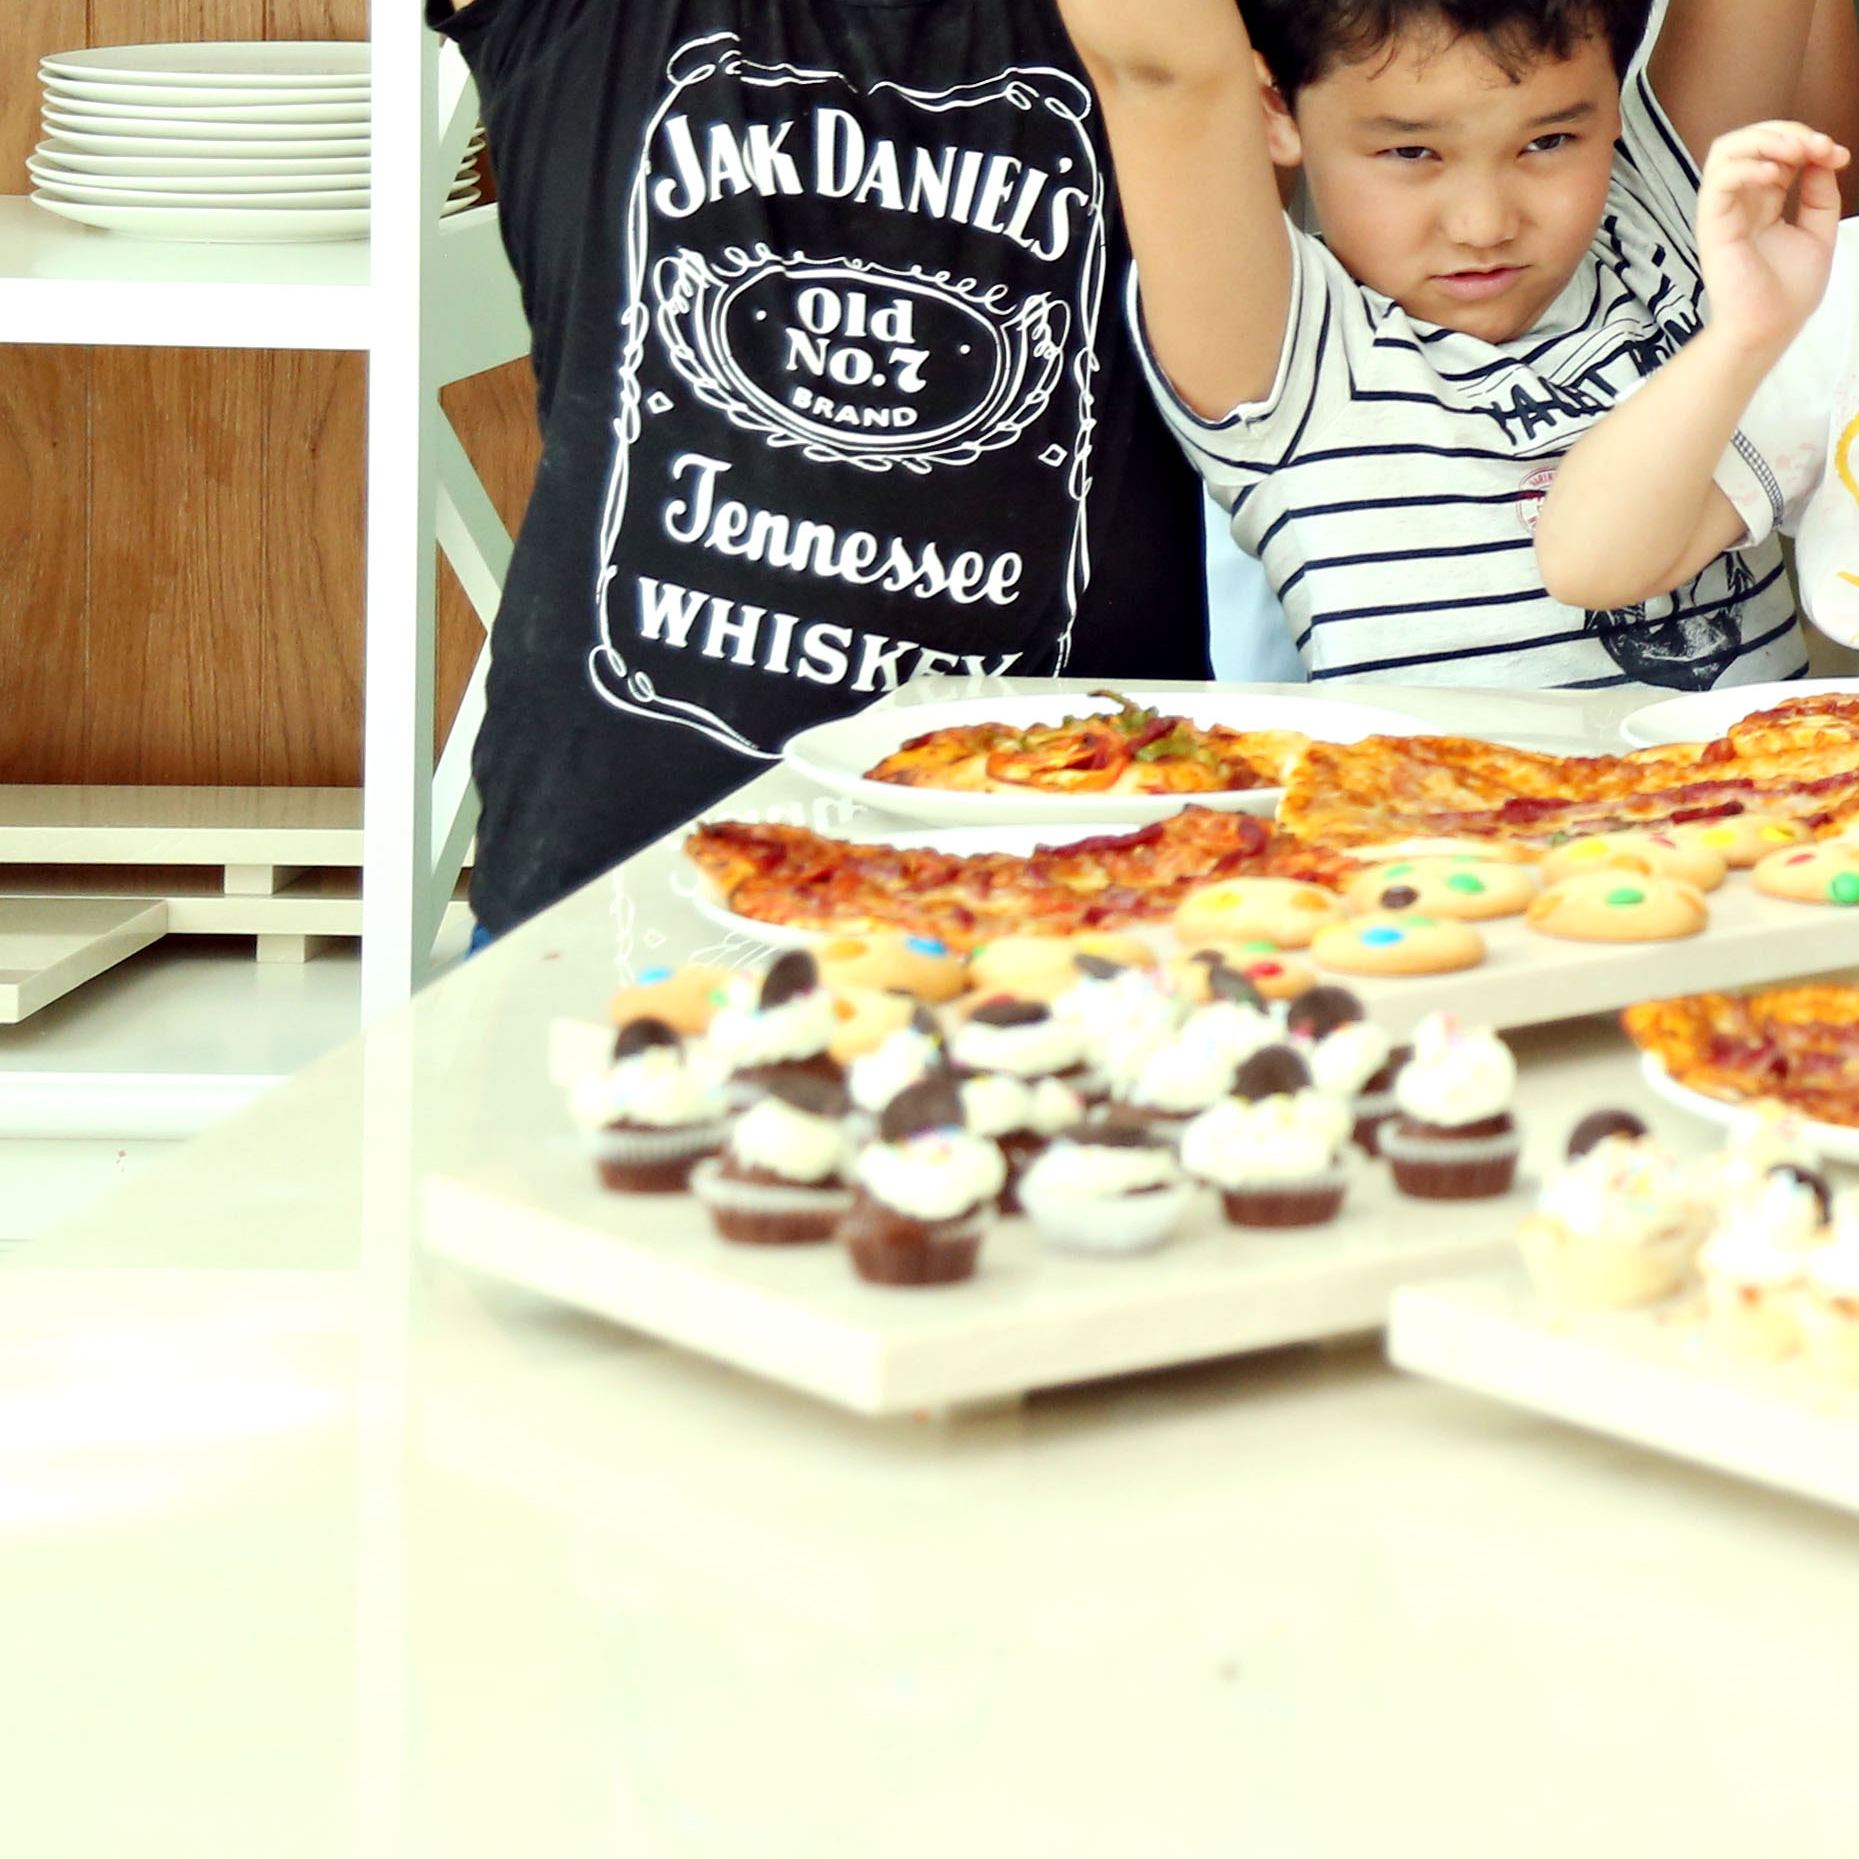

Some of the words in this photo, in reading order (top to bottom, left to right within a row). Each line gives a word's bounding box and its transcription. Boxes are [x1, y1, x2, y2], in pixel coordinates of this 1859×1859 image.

[815, 108, 1090, 261] DANIEL'S
[797, 287, 917, 344] Old
[791, 386, 919, 428] BRAND
[663, 453, 1023, 606] Tennessee
